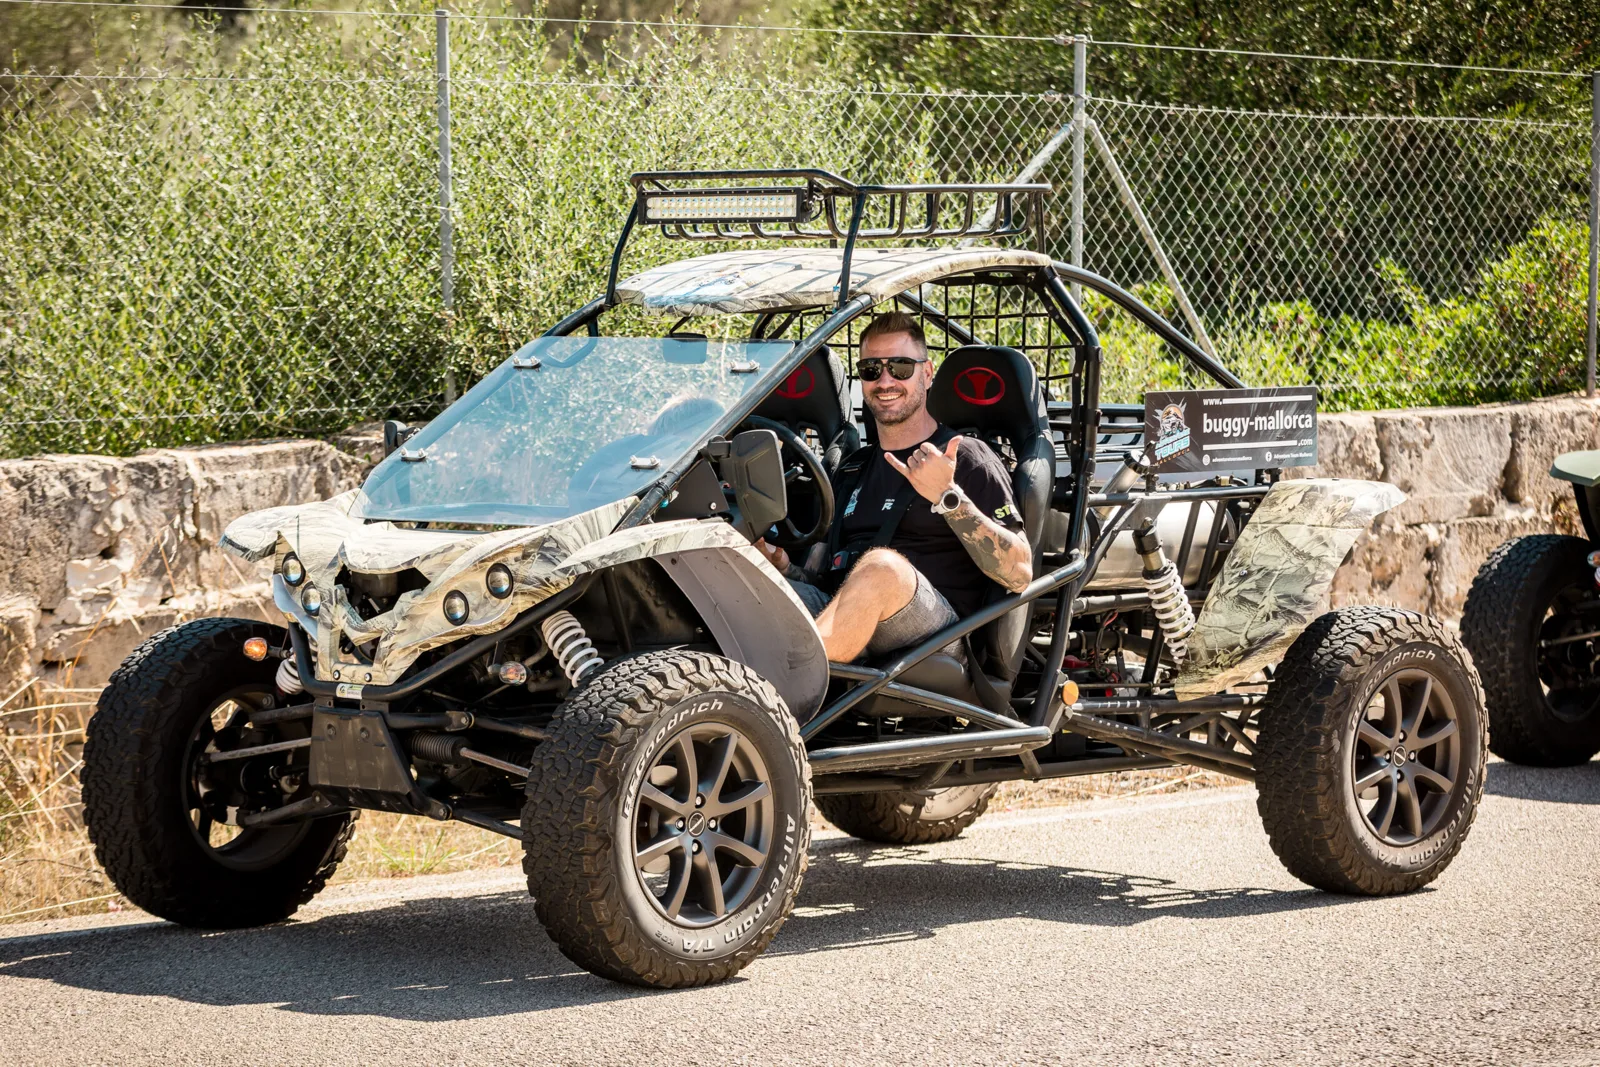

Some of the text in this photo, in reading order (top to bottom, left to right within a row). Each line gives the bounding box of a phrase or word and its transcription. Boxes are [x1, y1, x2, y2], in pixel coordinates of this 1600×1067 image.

[1203, 398, 1222, 406] www.
[1203, 410, 1313, 438] buggy-mallorca
[1155, 436, 1190, 460] TOURS
[1298, 438, 1313, 447] .com
[1349, 648, 1436, 731] BFGoodrich
[621, 699, 723, 819] BFGoodrich
[1409, 767, 1475, 866] All-Terrain
[724, 813, 796, 944] All-Terrain
[681, 938, 716, 953] T/A
